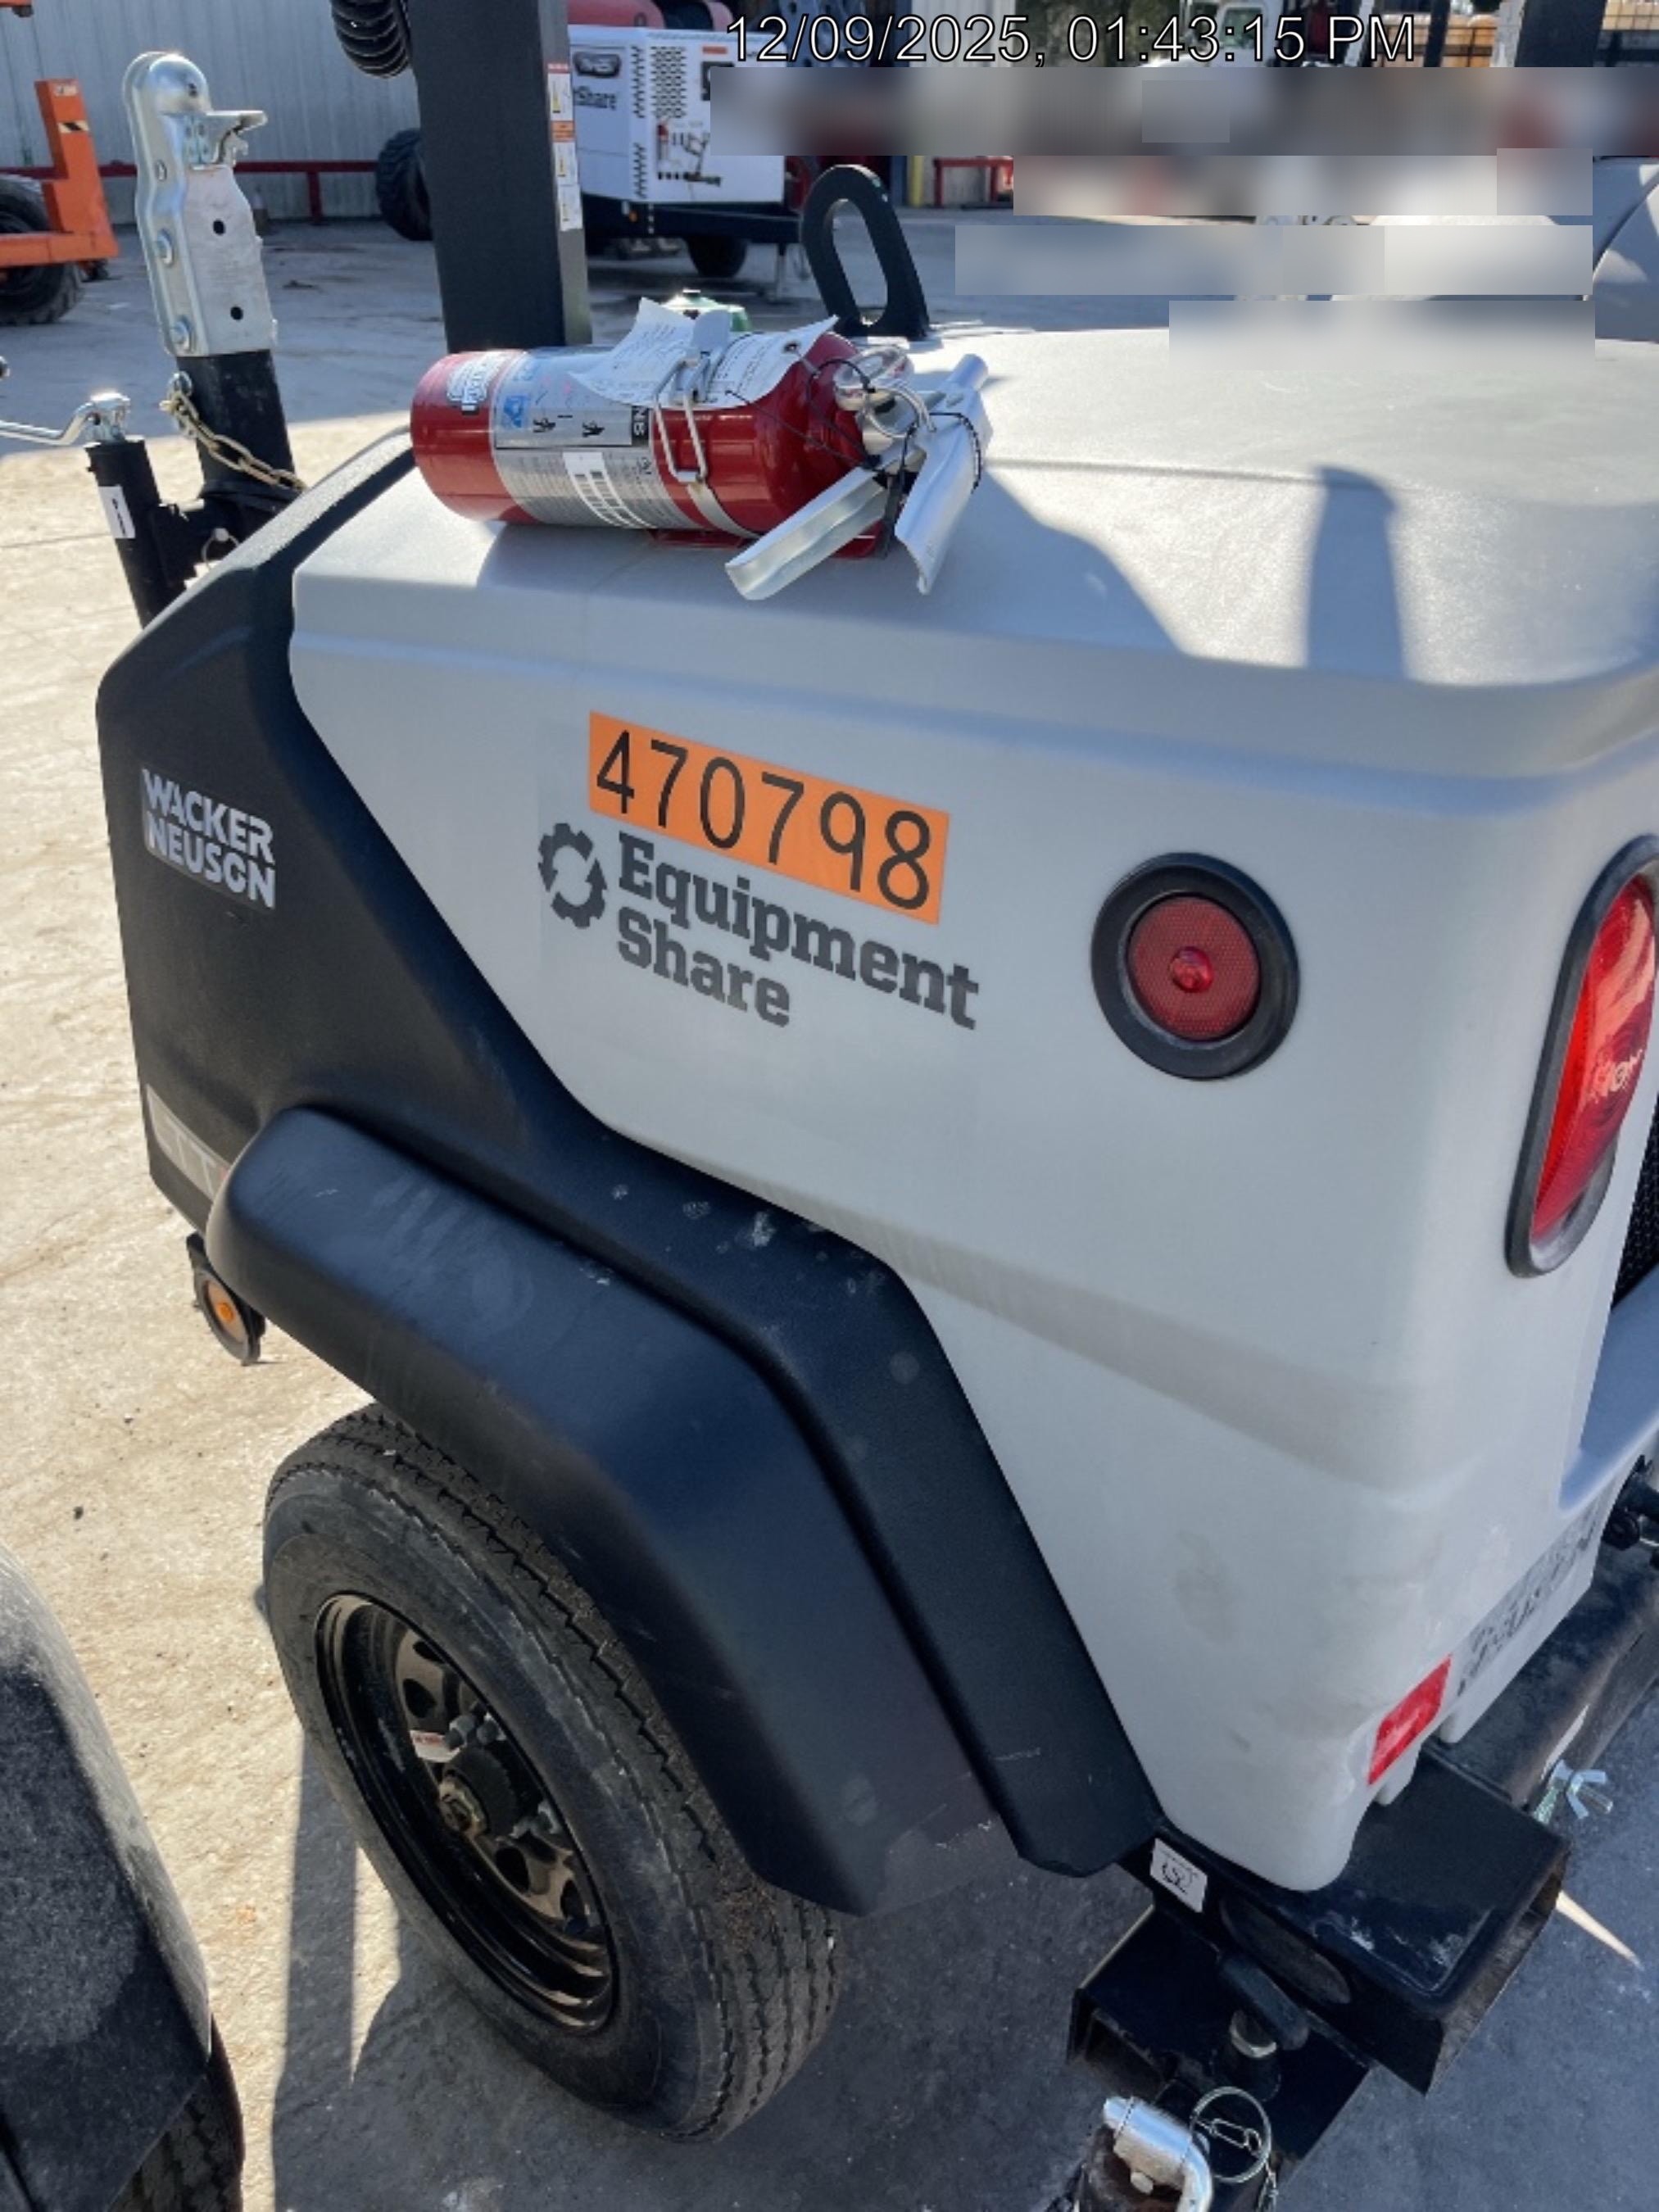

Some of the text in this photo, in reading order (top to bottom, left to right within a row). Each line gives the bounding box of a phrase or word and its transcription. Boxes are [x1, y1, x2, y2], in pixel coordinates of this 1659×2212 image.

[142, 768, 276, 865] WACKER
[146, 810, 276, 909] NEUSON
[596, 729, 931, 910] 470798
[617, 905, 791, 1028] Share
[618, 831, 980, 1031] Equipment
